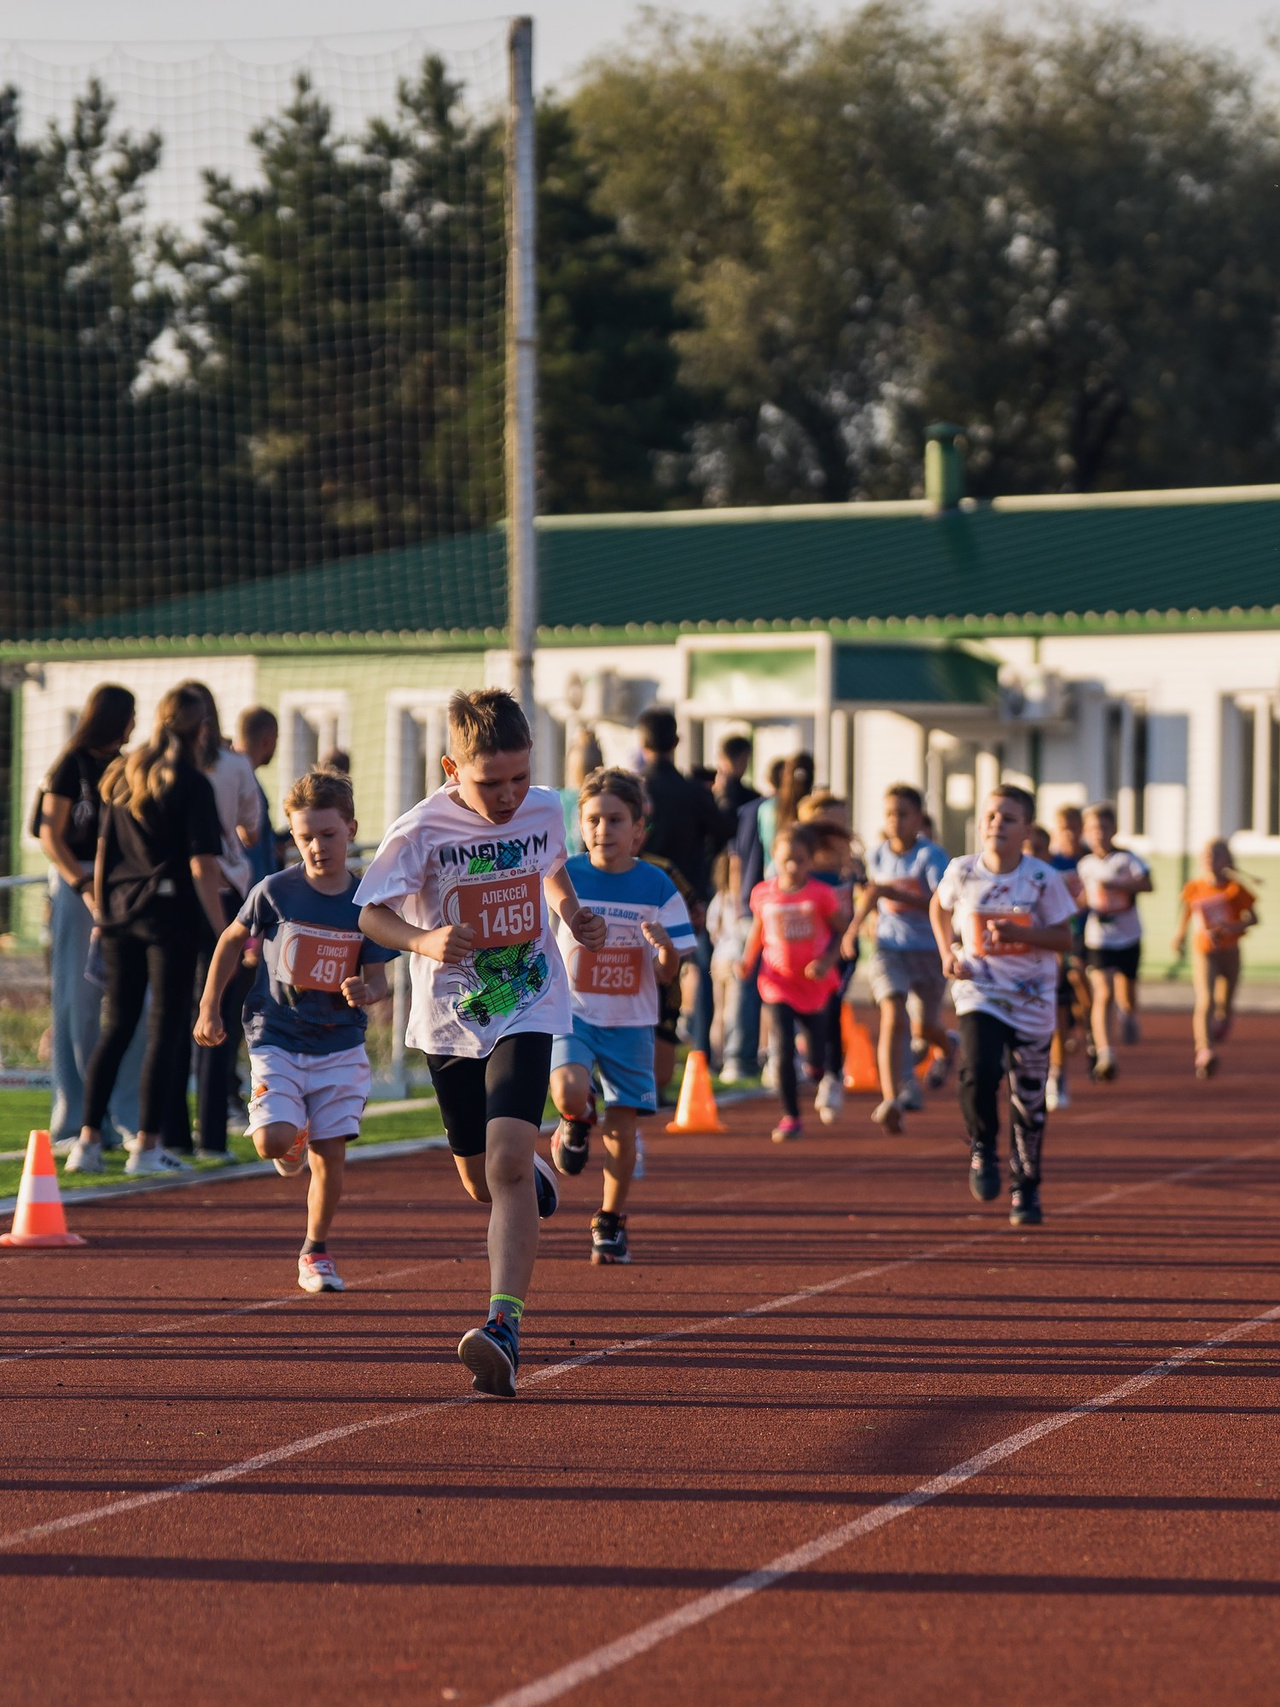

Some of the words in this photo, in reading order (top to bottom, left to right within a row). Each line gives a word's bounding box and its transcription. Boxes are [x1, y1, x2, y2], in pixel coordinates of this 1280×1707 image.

[482, 883, 528, 905] АЛЕКСЕЙ
[479, 901, 535, 938] 1459
[608, 907, 640, 921] LEAGUE
[317, 944, 348, 957] ЕЛИСЕЙ
[596, 953, 630, 963] КИРИЛЛ
[309, 958, 346, 984] 491
[591, 965, 635, 988] 1235
